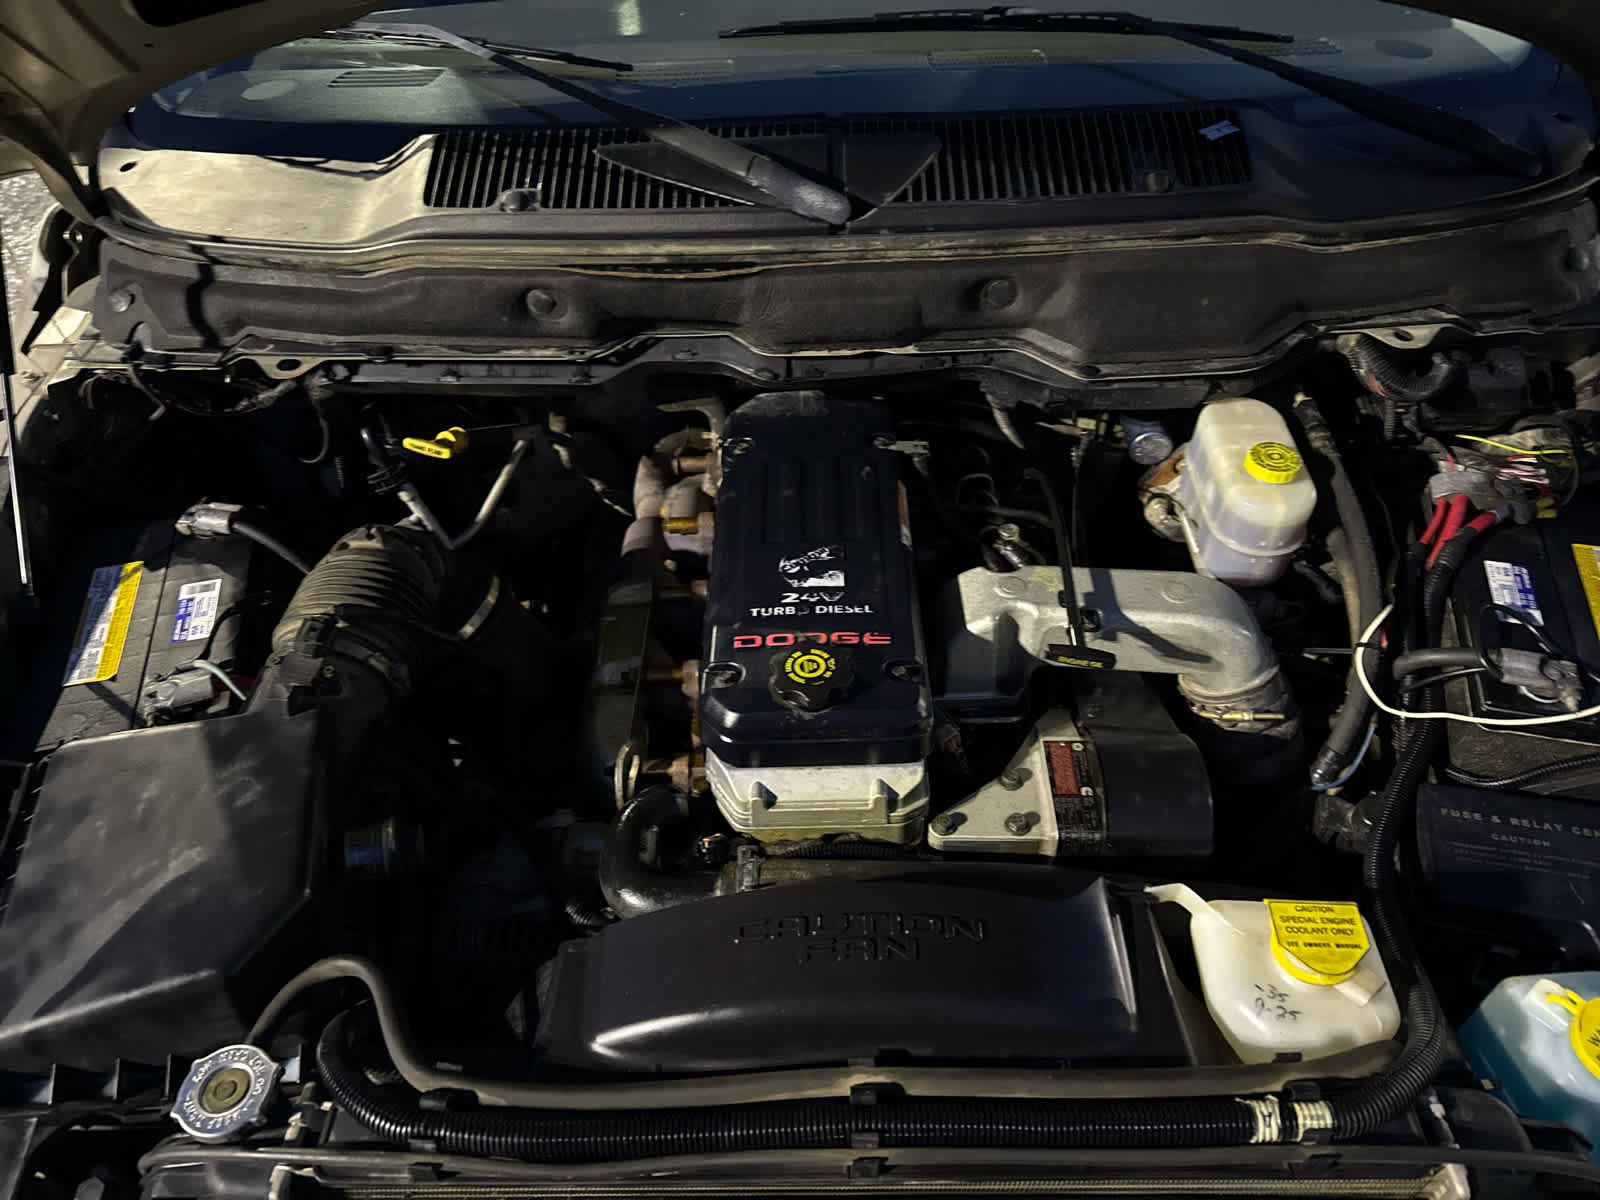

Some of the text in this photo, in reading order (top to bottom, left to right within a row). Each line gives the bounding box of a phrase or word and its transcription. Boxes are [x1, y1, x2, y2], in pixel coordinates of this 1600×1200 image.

[815, 604, 875, 614] DIESEL
[1440, 807, 1483, 821] FUSE
[1509, 817, 1564, 832] RELAY
[1490, 832, 1552, 848] CAUTION
[734, 911, 986, 943] CAUTION
[1279, 915, 1358, 926] SPECIAL ENGINE
[1285, 926, 1355, 936] COOLANT ONLY
[799, 935, 921, 965] FAN
